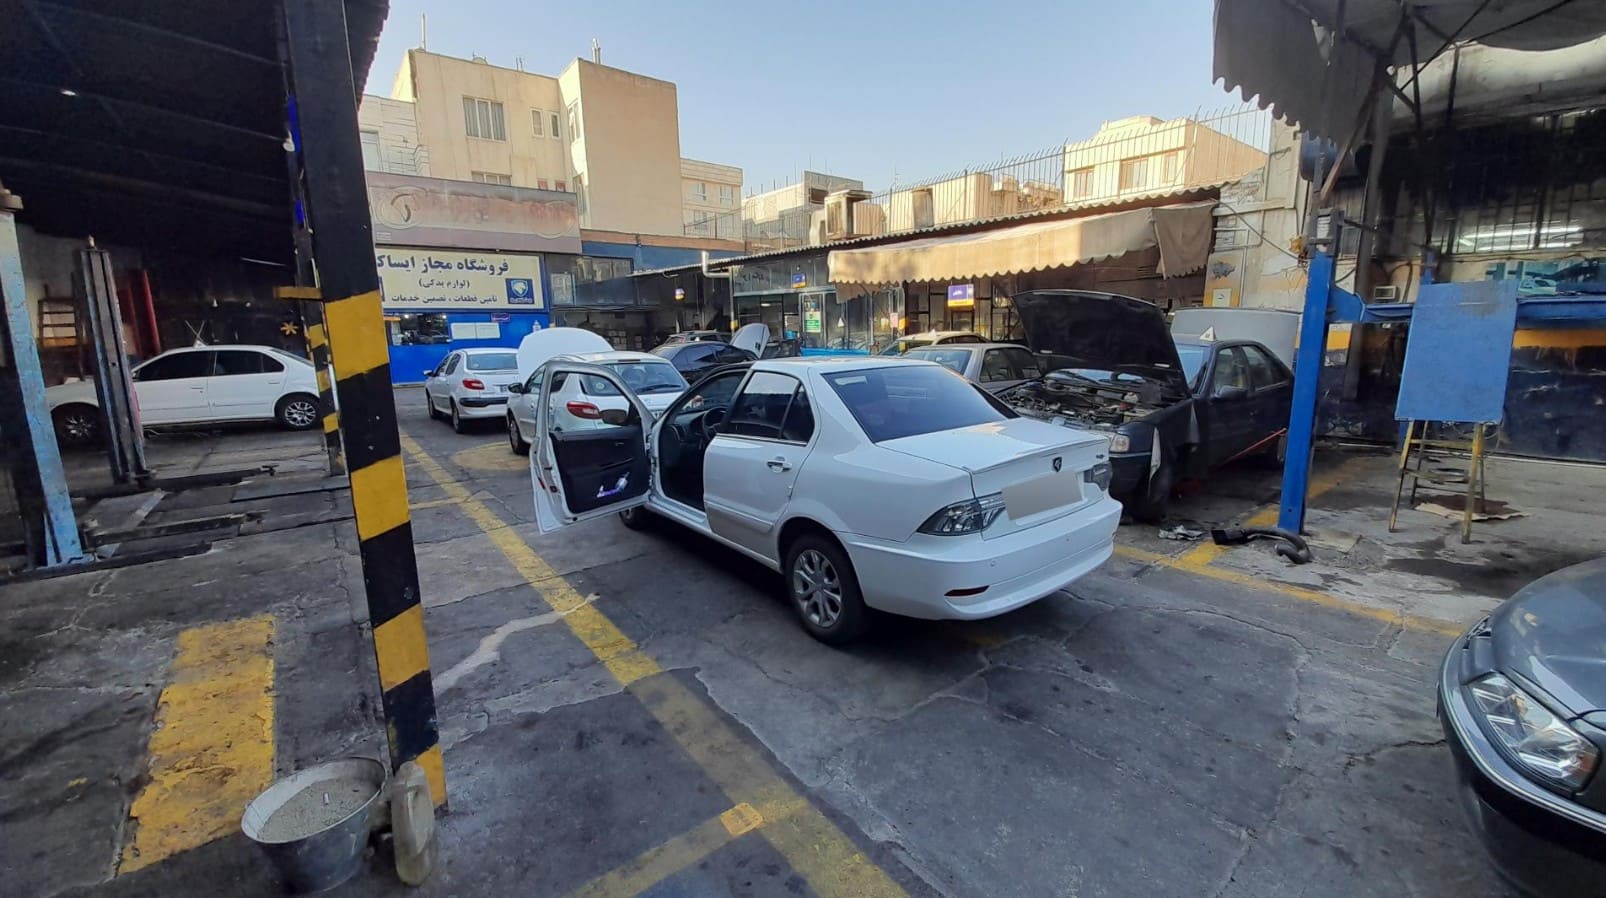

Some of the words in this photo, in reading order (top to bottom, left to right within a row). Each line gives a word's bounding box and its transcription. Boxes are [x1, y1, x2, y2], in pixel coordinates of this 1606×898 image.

[376, 254, 416, 272] ایساک
[422, 256, 453, 274] مجاز
[456, 257, 509, 276] فروشگاه
[391, 294, 420, 303] خدمات
[453, 294, 478, 303] قطعات
